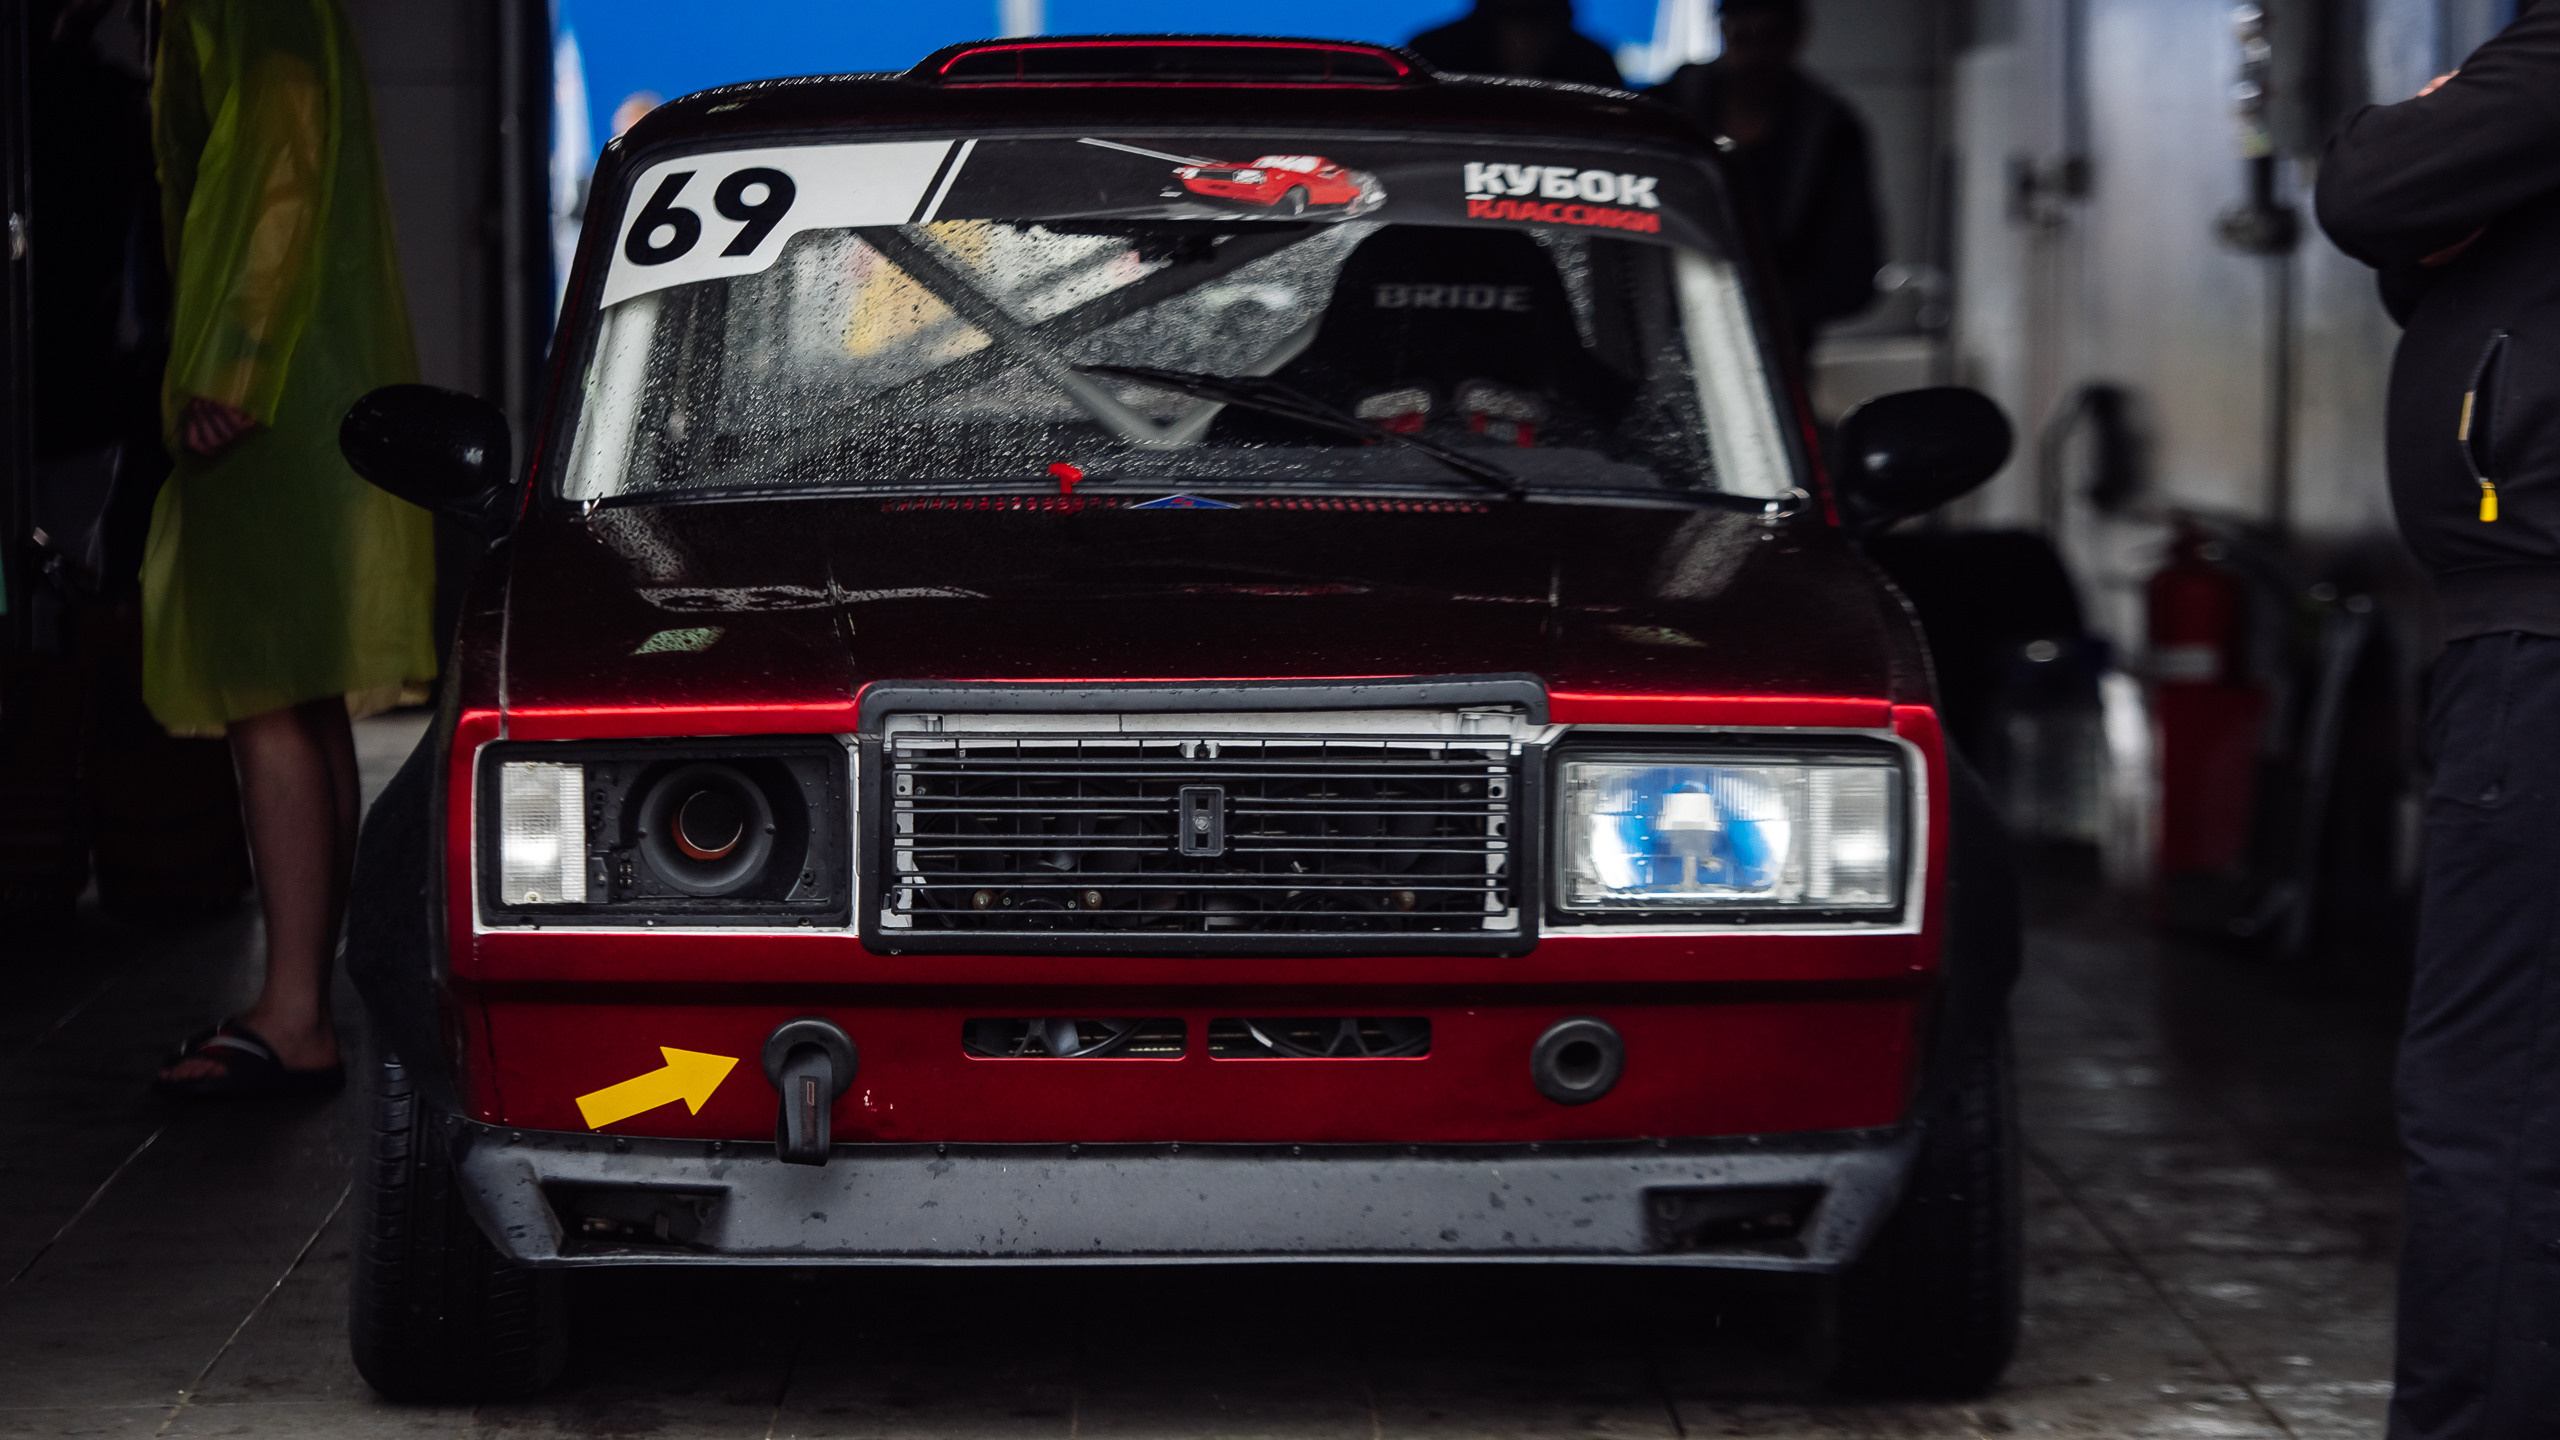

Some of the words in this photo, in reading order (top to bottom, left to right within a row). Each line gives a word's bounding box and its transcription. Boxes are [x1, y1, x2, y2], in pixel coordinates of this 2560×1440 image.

[1464, 162, 1660, 208] КУБОК
[625, 167, 796, 265] 69
[1467, 199, 1661, 233] КЛАССИКИ
[1374, 283, 1533, 312] BRIDE
